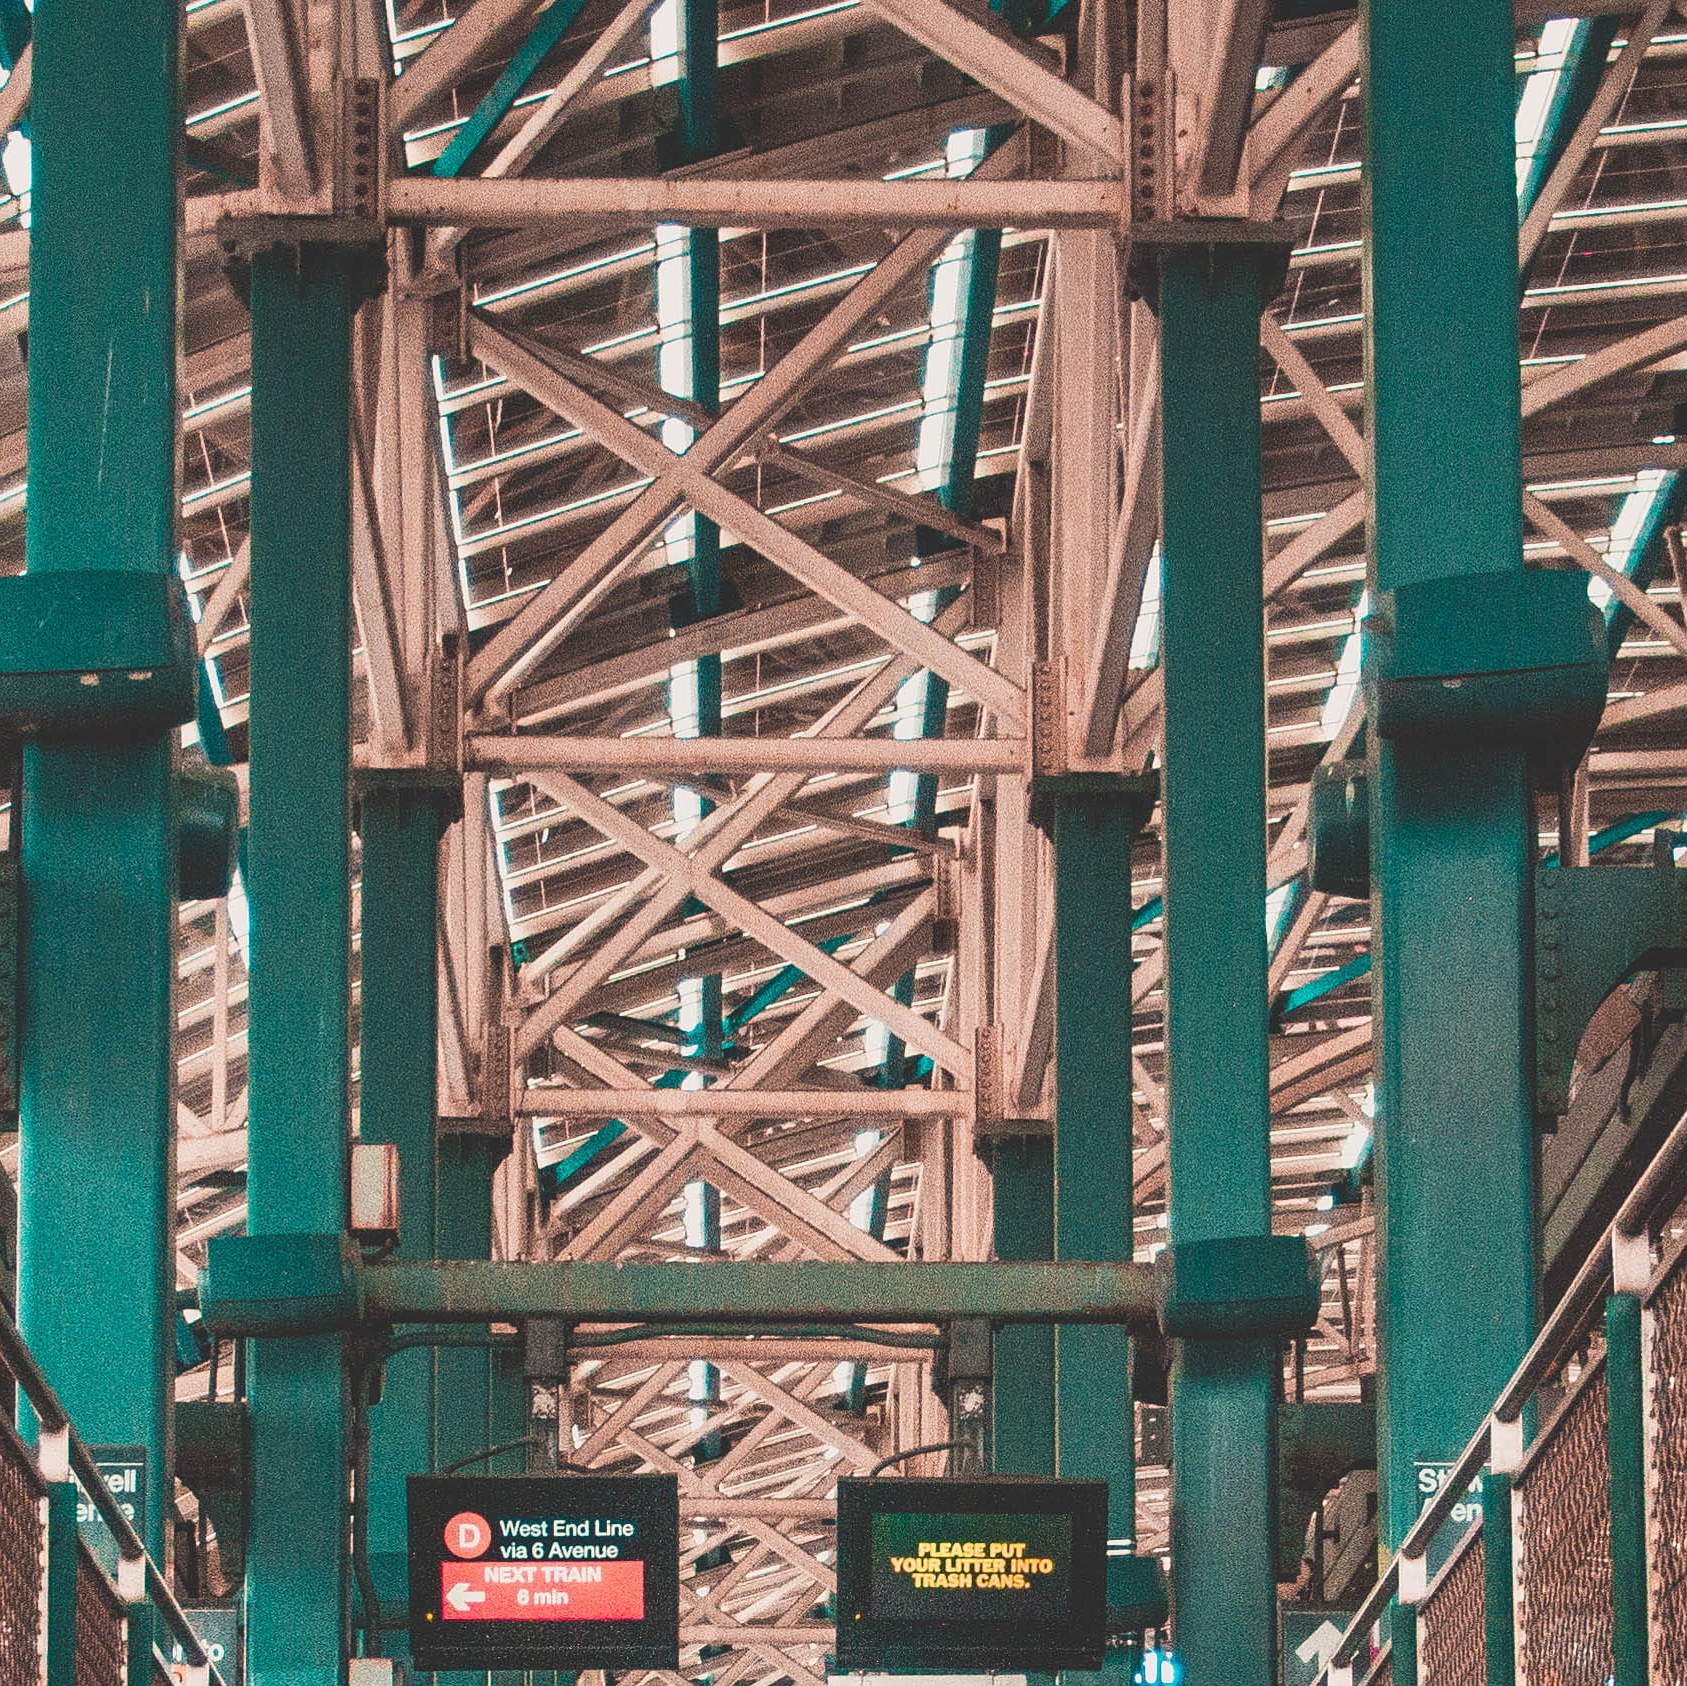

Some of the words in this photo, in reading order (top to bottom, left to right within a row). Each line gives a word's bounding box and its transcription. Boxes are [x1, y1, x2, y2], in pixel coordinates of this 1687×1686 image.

[459, 1524, 481, 1548] D
[500, 1520, 548, 1537] West
[553, 1520, 589, 1537] End
[595, 1520, 635, 1537] Line
[501, 1542, 527, 1559] via
[532, 1542, 544, 1559] 6
[549, 1542, 618, 1559] Avenue
[918, 1543, 985, 1558] PLEASE
[990, 1543, 1026, 1558] PUT
[890, 1558, 940, 1573] YOUR
[945, 1558, 1005, 1573] LITTER
[1011, 1558, 1053, 1574] INTO
[484, 1567, 537, 1583] NEXT
[542, 1567, 602, 1583] TRAIN
[912, 1573, 972, 1588] TRASH
[977, 1573, 1030, 1589] CANS.
[517, 1589, 529, 1605] 6
[534, 1589, 569, 1605] min
